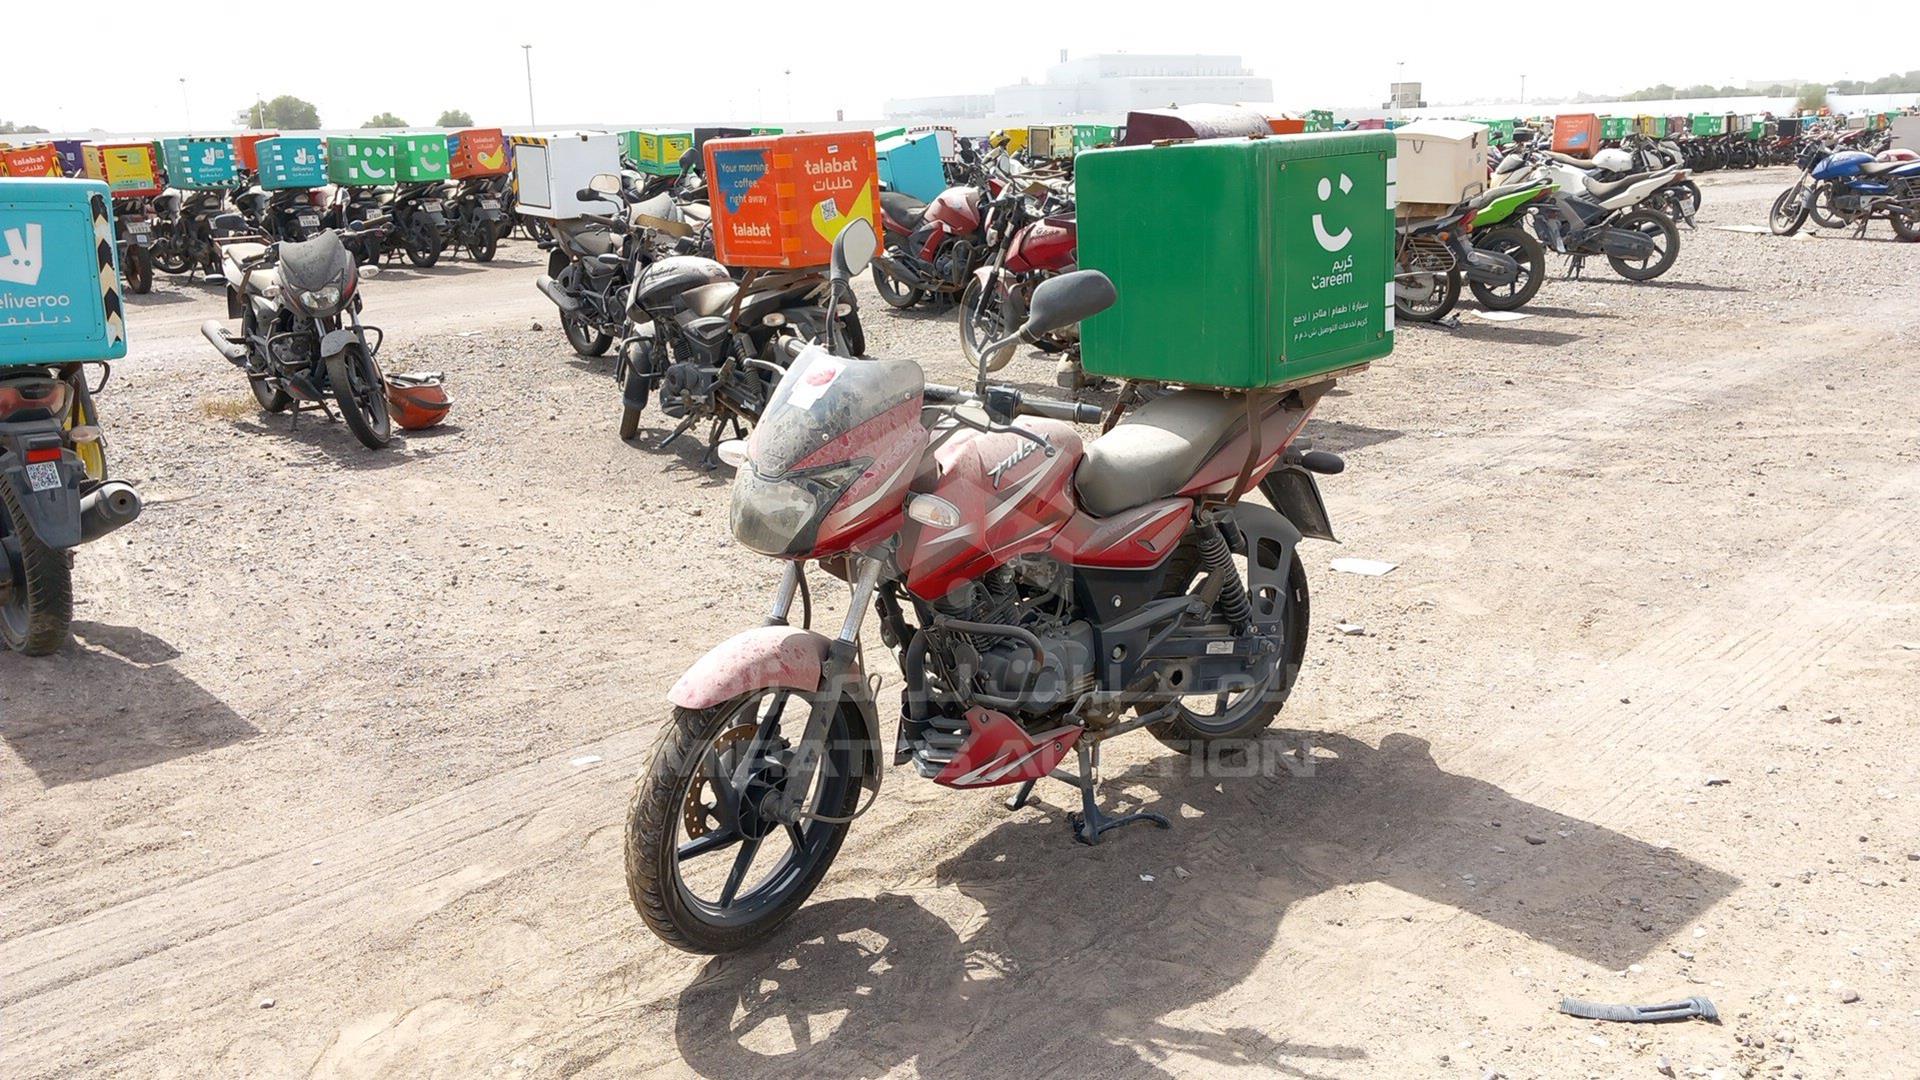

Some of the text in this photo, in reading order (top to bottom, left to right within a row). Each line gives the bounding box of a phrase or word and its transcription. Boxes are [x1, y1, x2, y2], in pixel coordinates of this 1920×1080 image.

[12, 155, 46, 166] talabat
[720, 162, 770, 175] Your morning
[804, 156, 858, 175] talabat
[813, 177, 853, 194] طلبات
[729, 193, 767, 206] right away
[732, 222, 771, 237] talabat
[1331, 254, 1353, 273] كريم
[1311, 271, 1353, 290] Careem
